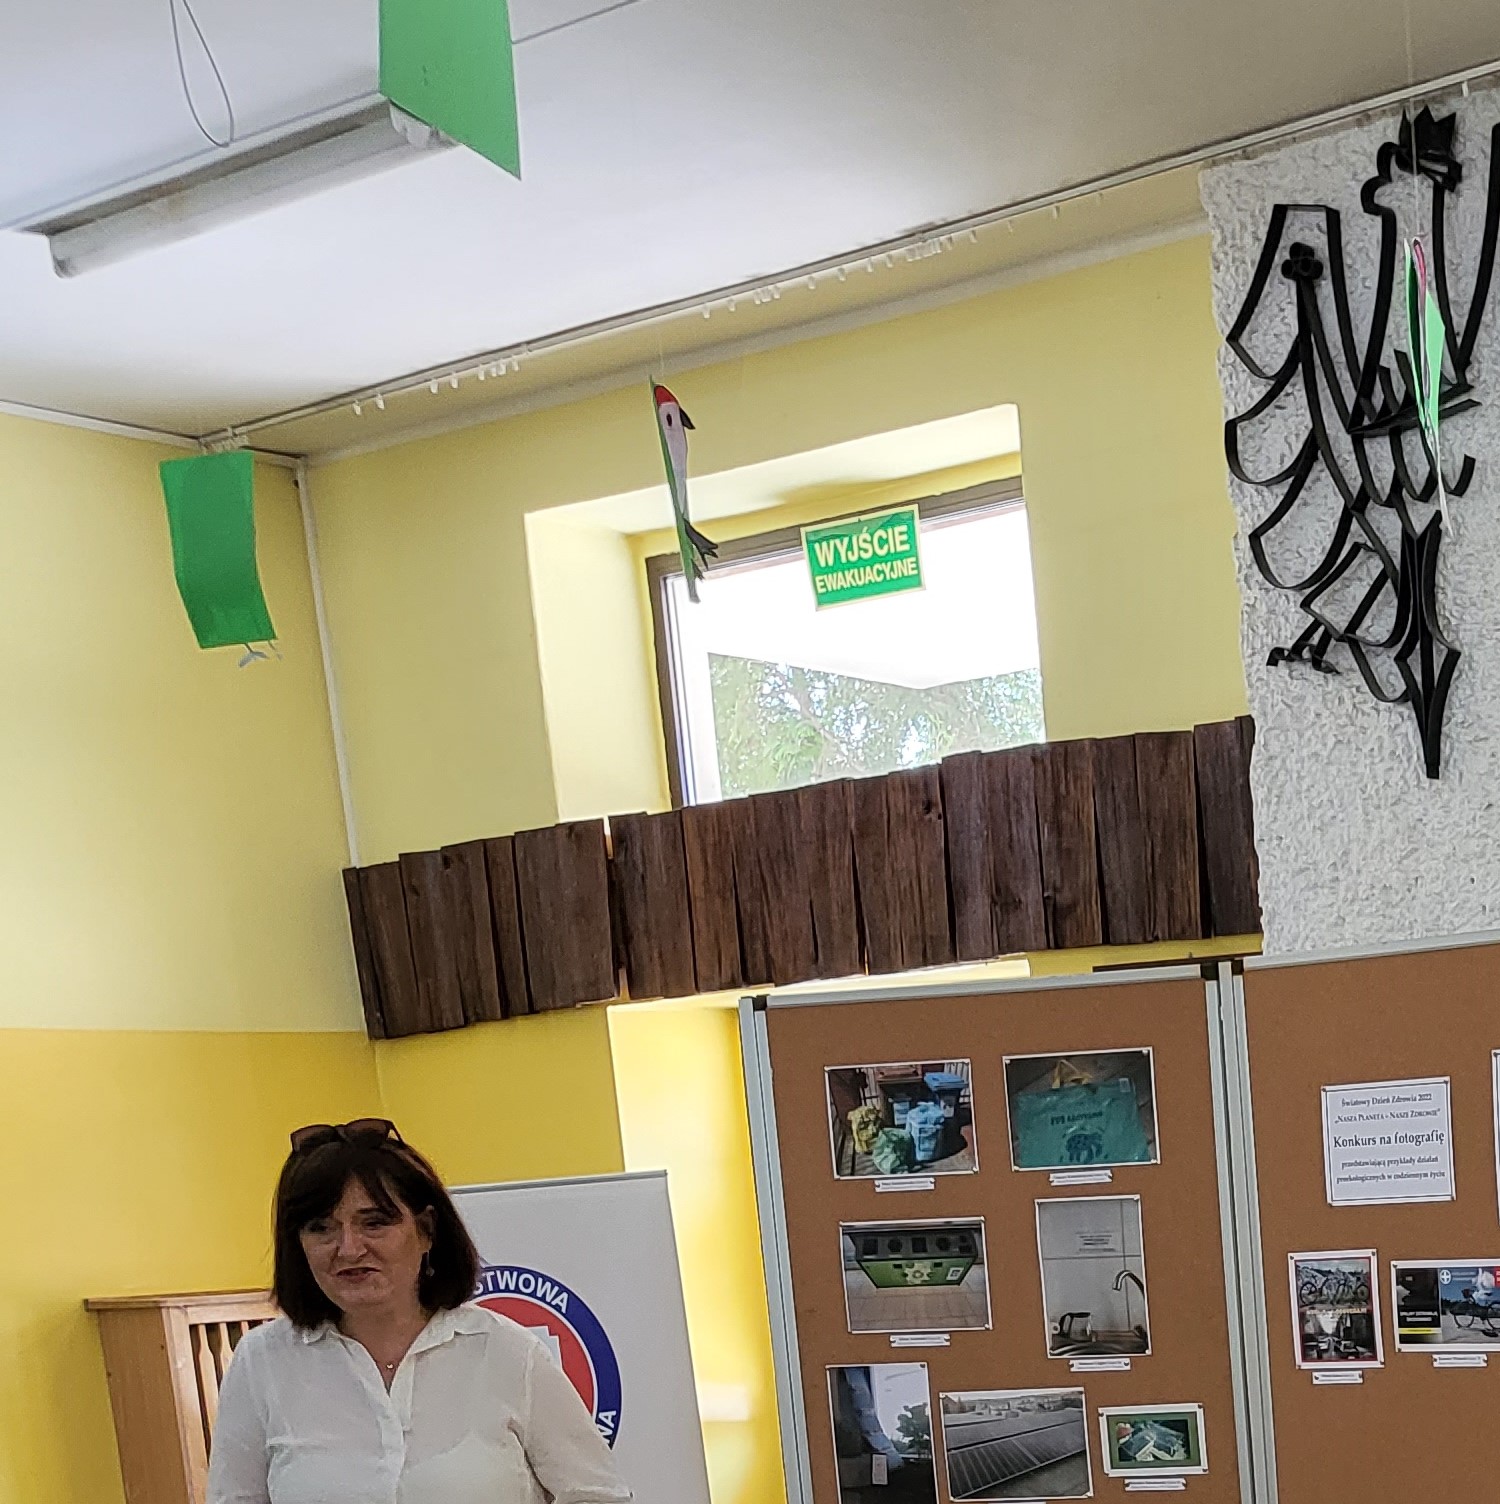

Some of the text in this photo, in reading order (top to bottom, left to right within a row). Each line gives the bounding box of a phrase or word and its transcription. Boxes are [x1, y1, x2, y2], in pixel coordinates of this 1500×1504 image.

[814, 524, 910, 568] WYJŚCIE
[815, 556, 918, 594] EWAKUACYJNE
[1371, 1096, 1390, 1105] Dzień
[1391, 1094, 1417, 1104] Zdrowia
[1333, 1129, 1445, 1148] Konkurs na fotografię
